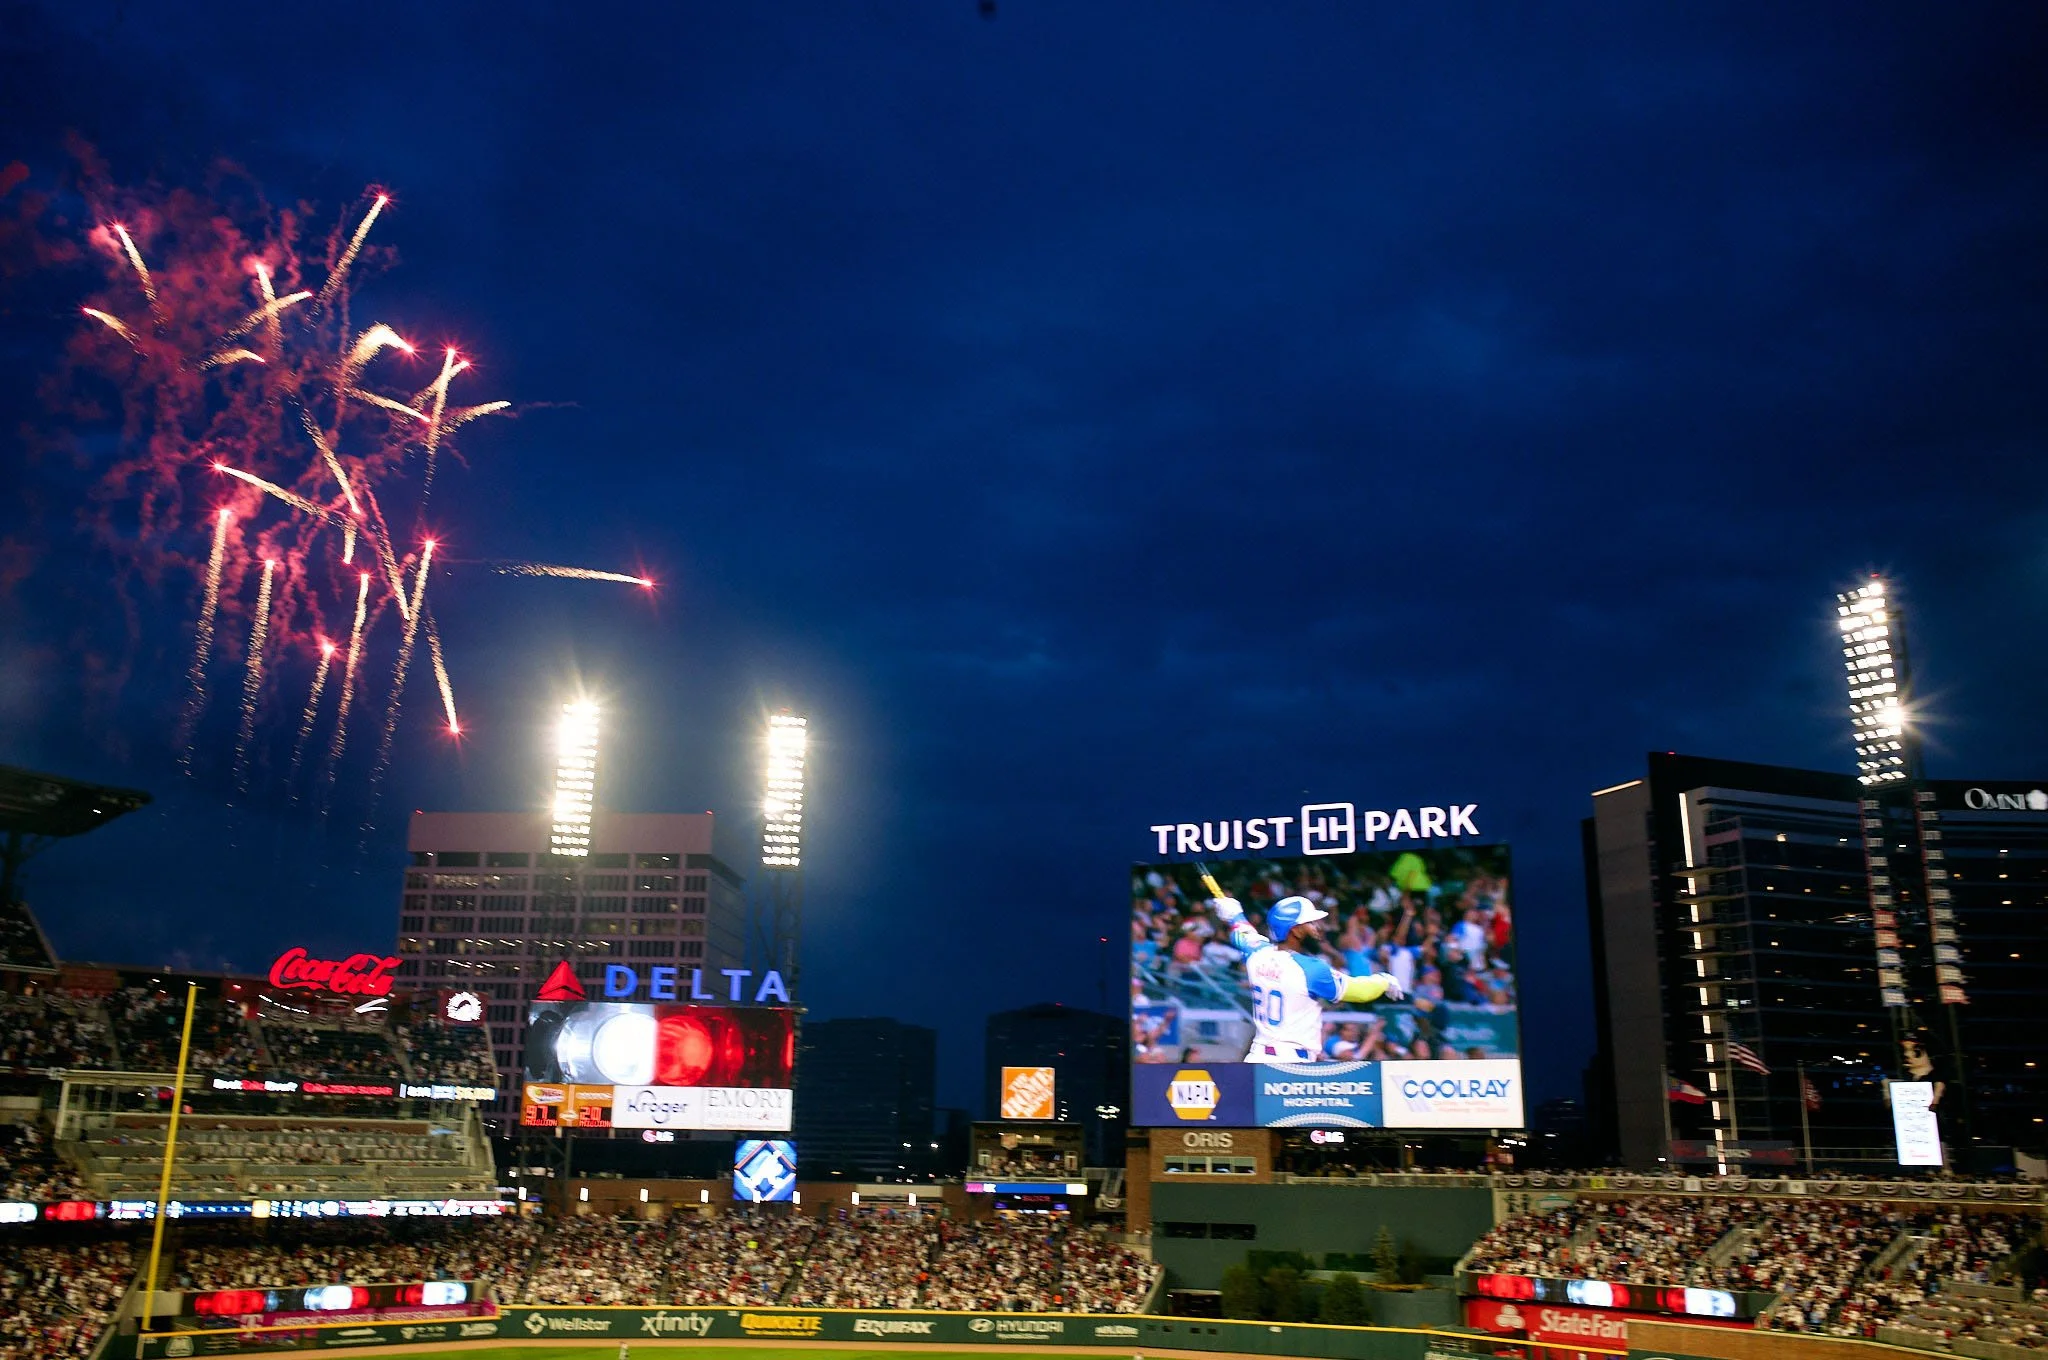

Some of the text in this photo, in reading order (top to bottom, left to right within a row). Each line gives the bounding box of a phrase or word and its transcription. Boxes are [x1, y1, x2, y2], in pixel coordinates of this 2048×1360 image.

[1150, 804, 1481, 855] TRUIST PARK
[268, 946, 404, 996] Coca-Cola
[603, 963, 791, 1004] DELTA
[1263, 1081, 1374, 1096] NORTHSIDE
[1402, 1079, 1513, 1099] COOLRAY
[627, 1089, 690, 1124] Kroger
[706, 1088, 786, 1109] EMORY
[1283, 1097, 1355, 1107] HOSPITAL
[579, 1106, 603, 1121] 20
[1182, 1132, 1234, 1148] ORIS
[547, 1316, 612, 1332] Wellstar
[640, 1310, 714, 1337] xfinity
[853, 1318, 937, 1337] EQUIFAX
[995, 1319, 1064, 1334] HYUNDAI
